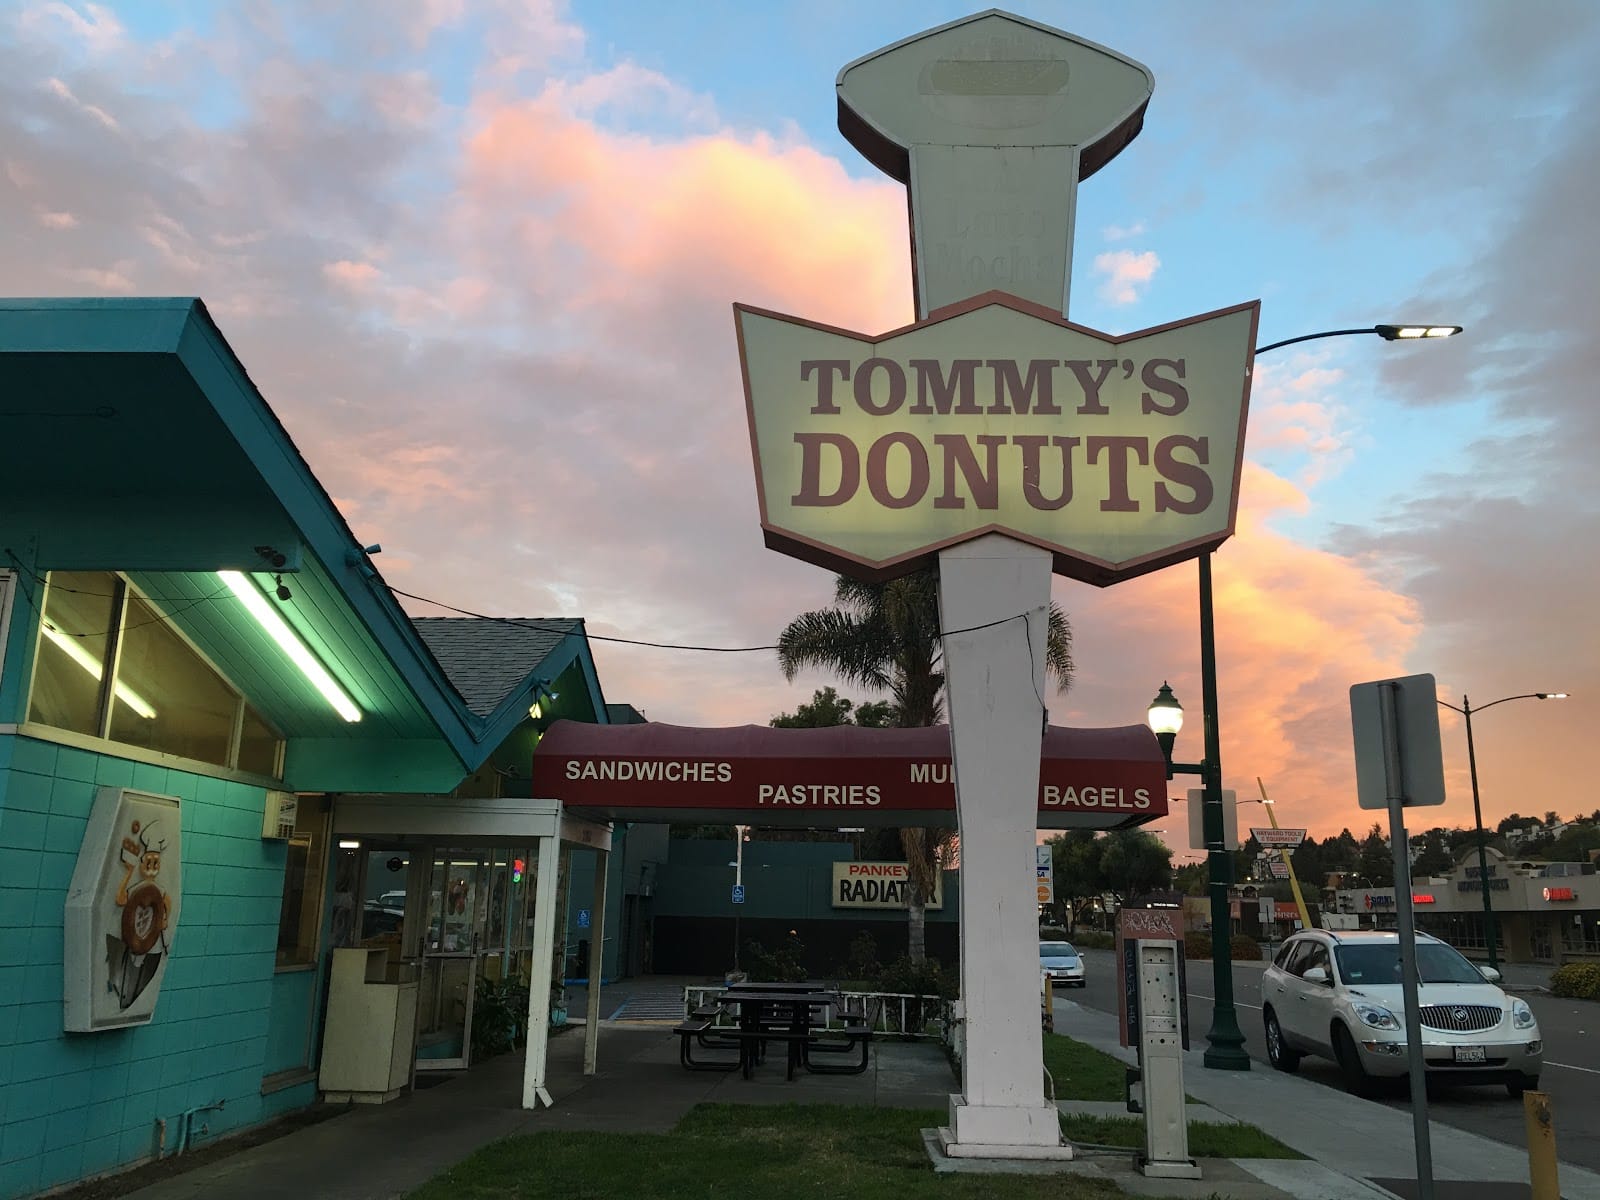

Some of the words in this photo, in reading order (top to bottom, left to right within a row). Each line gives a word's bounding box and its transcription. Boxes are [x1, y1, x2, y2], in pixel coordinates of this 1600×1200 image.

[800, 357, 1190, 416] TOMMY'S
[791, 431, 1214, 515] DONUTS
[565, 760, 732, 783] SANDWICHES
[758, 784, 881, 806] PASTRIES
[1043, 785, 1151, 809] BAGELS
[840, 879, 937, 904] RADIAT
